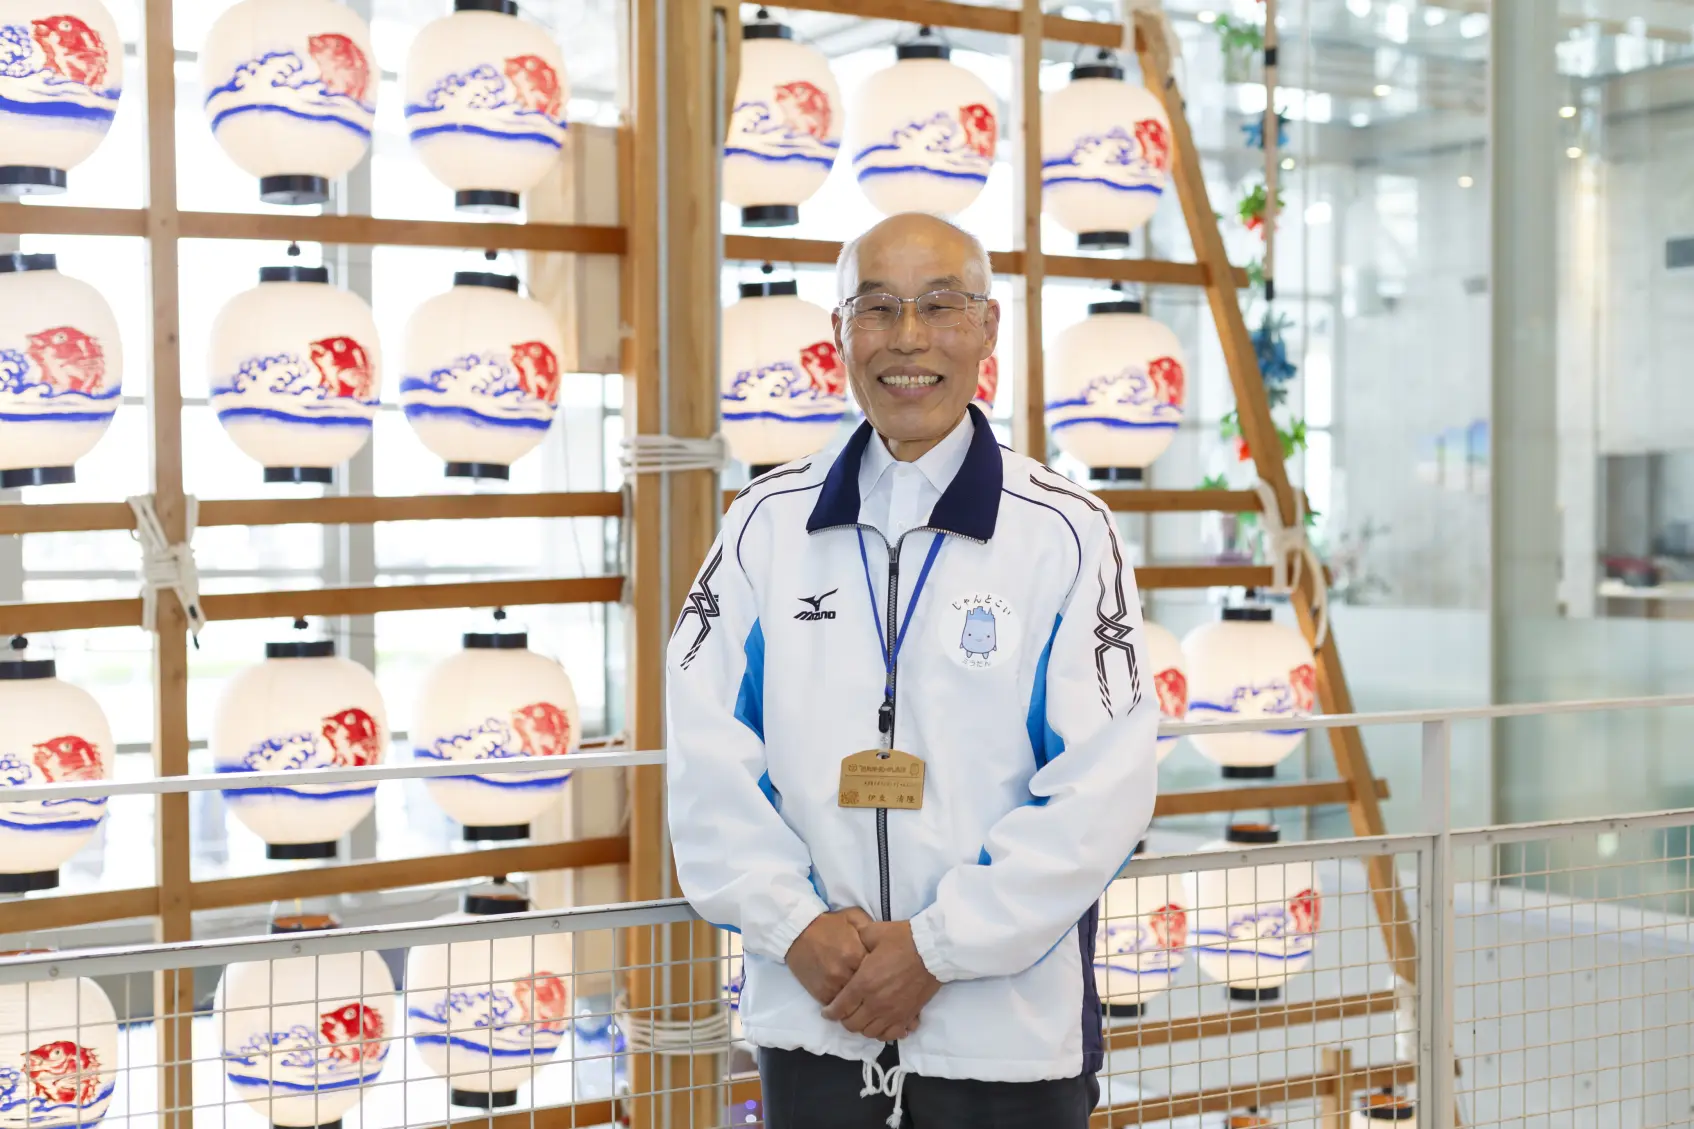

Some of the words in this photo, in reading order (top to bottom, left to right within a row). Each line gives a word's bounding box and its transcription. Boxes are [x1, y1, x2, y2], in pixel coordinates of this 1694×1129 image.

[952, 594, 1011, 615] じゃんとこい
